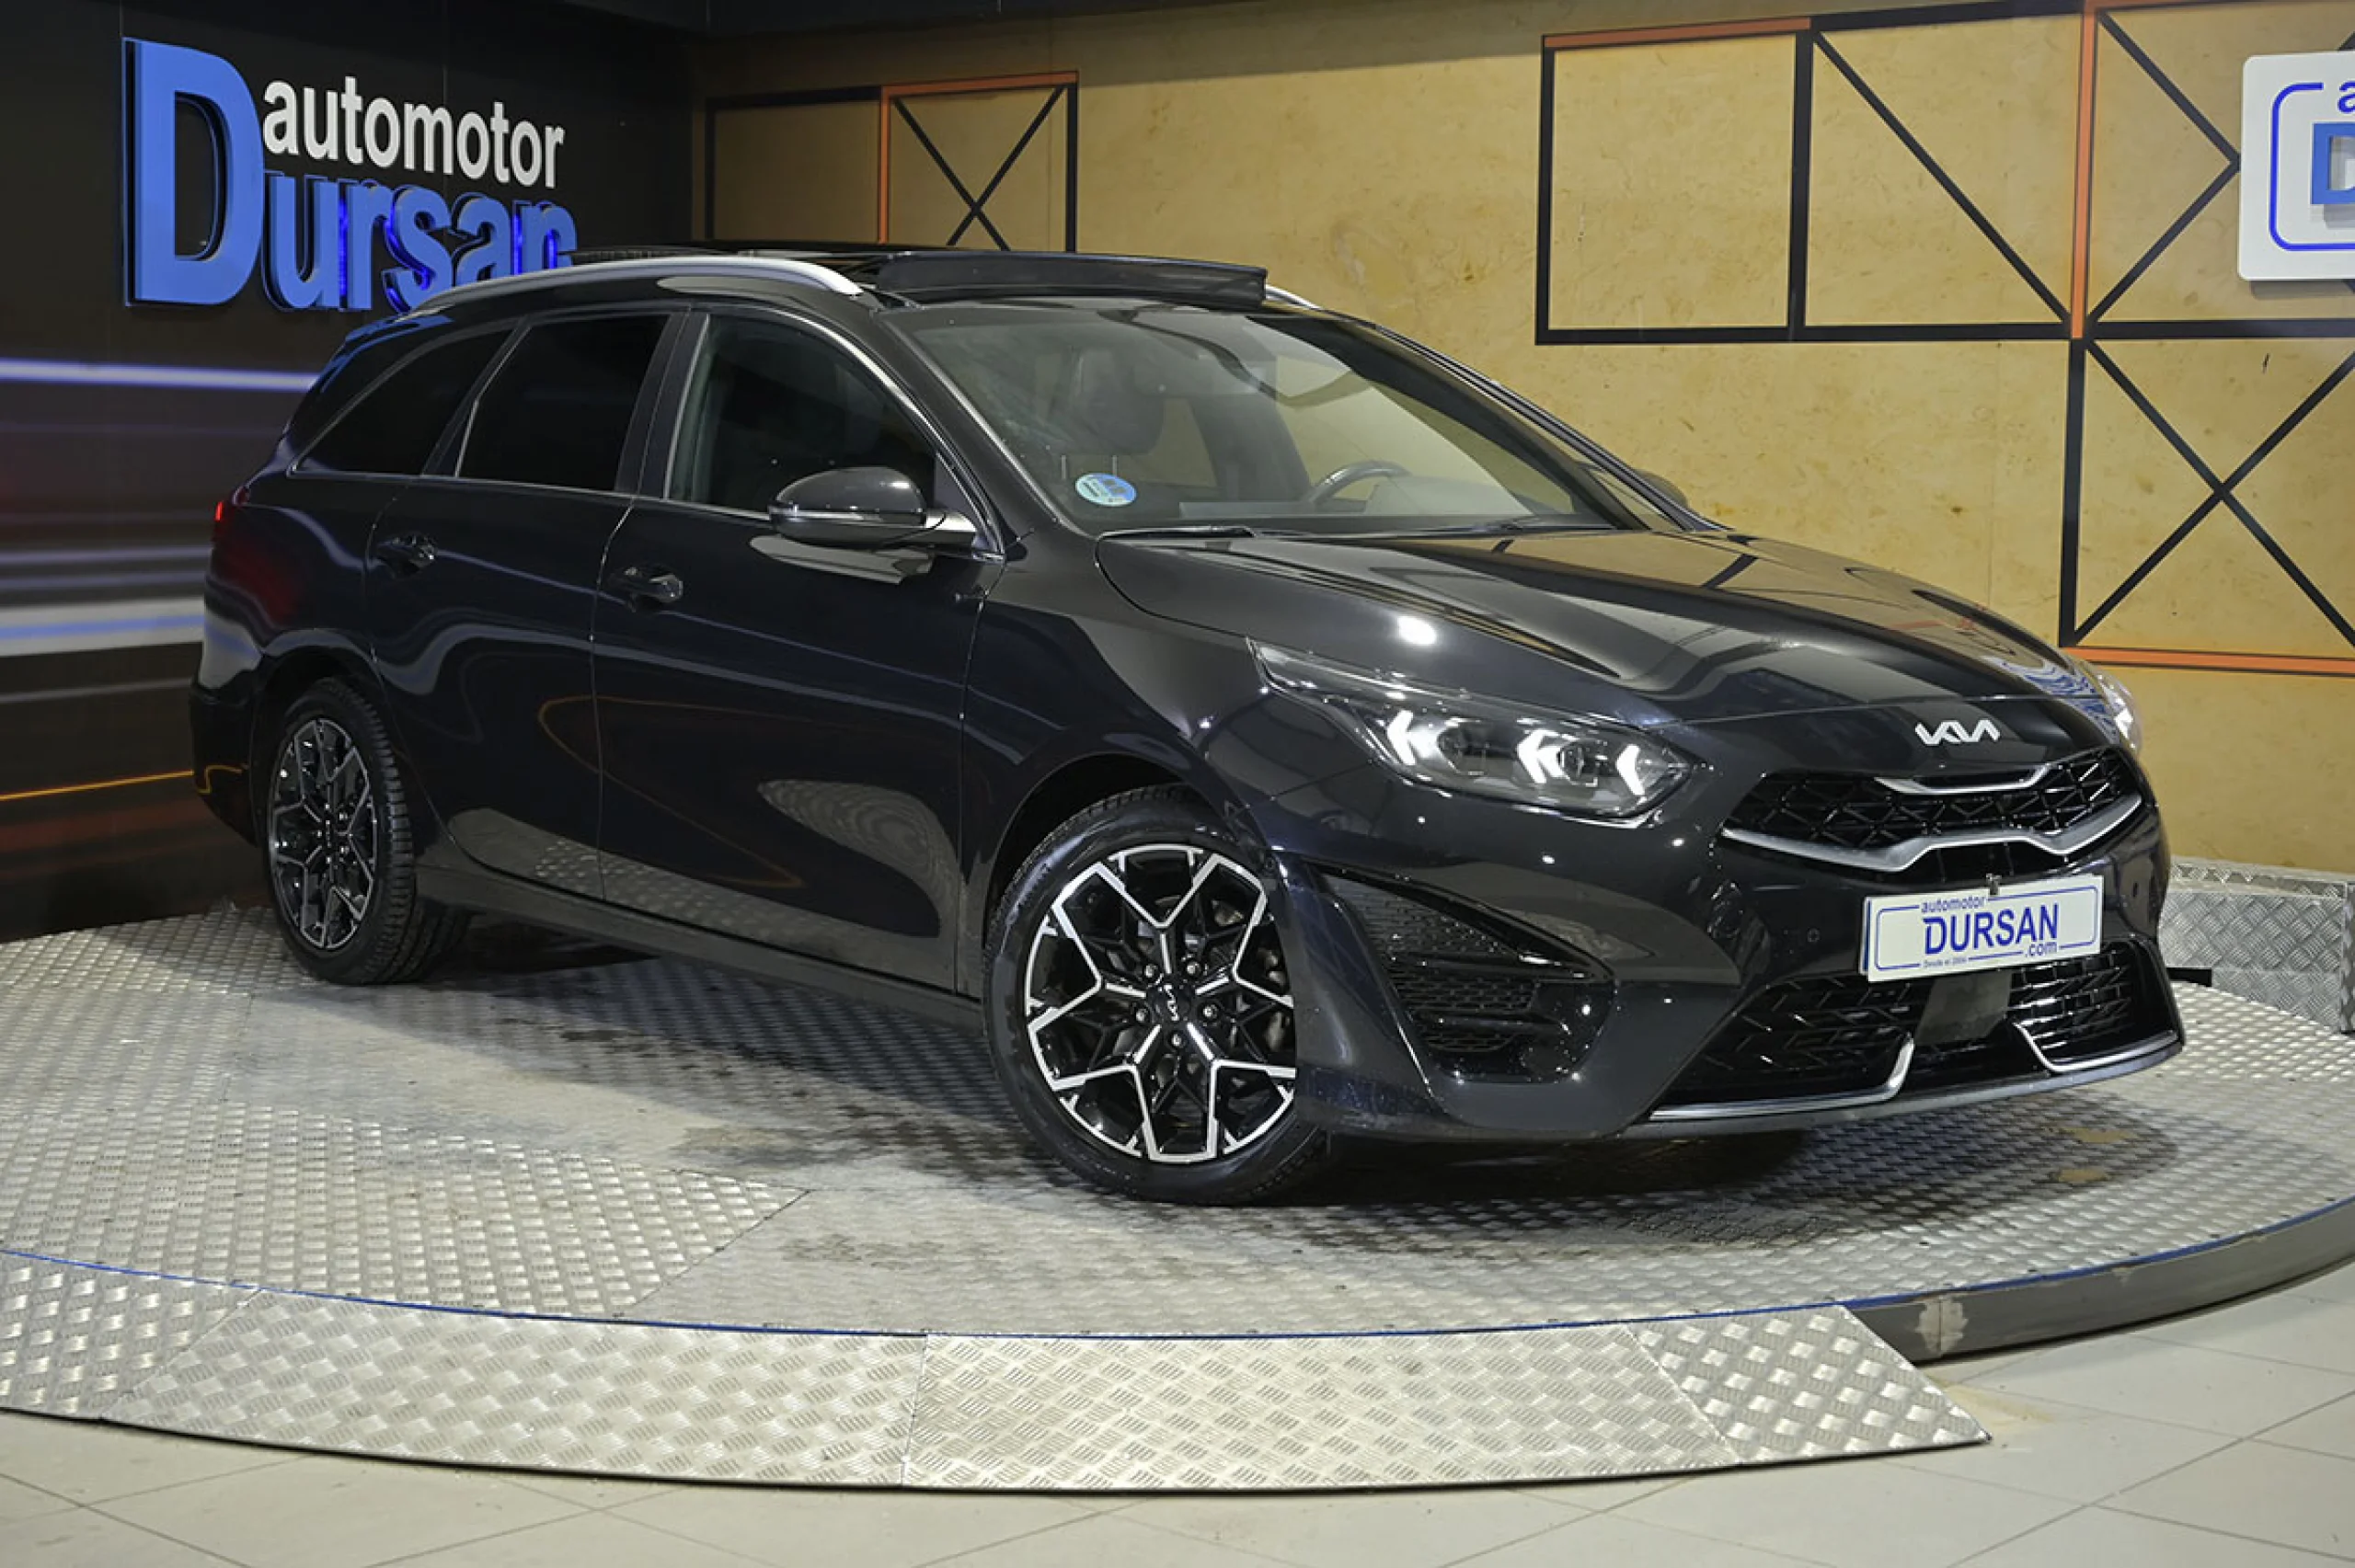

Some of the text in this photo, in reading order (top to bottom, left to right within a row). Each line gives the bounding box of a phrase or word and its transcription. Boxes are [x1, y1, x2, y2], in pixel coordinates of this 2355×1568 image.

[263, 76, 565, 189] automotor
[122, 37, 578, 313] Dursan
[1914, 719, 2001, 747] KIA
[1921, 896, 1986, 913] automotor
[1923, 902, 2059, 956] DURSAN
[2025, 942, 2058, 958] .com
